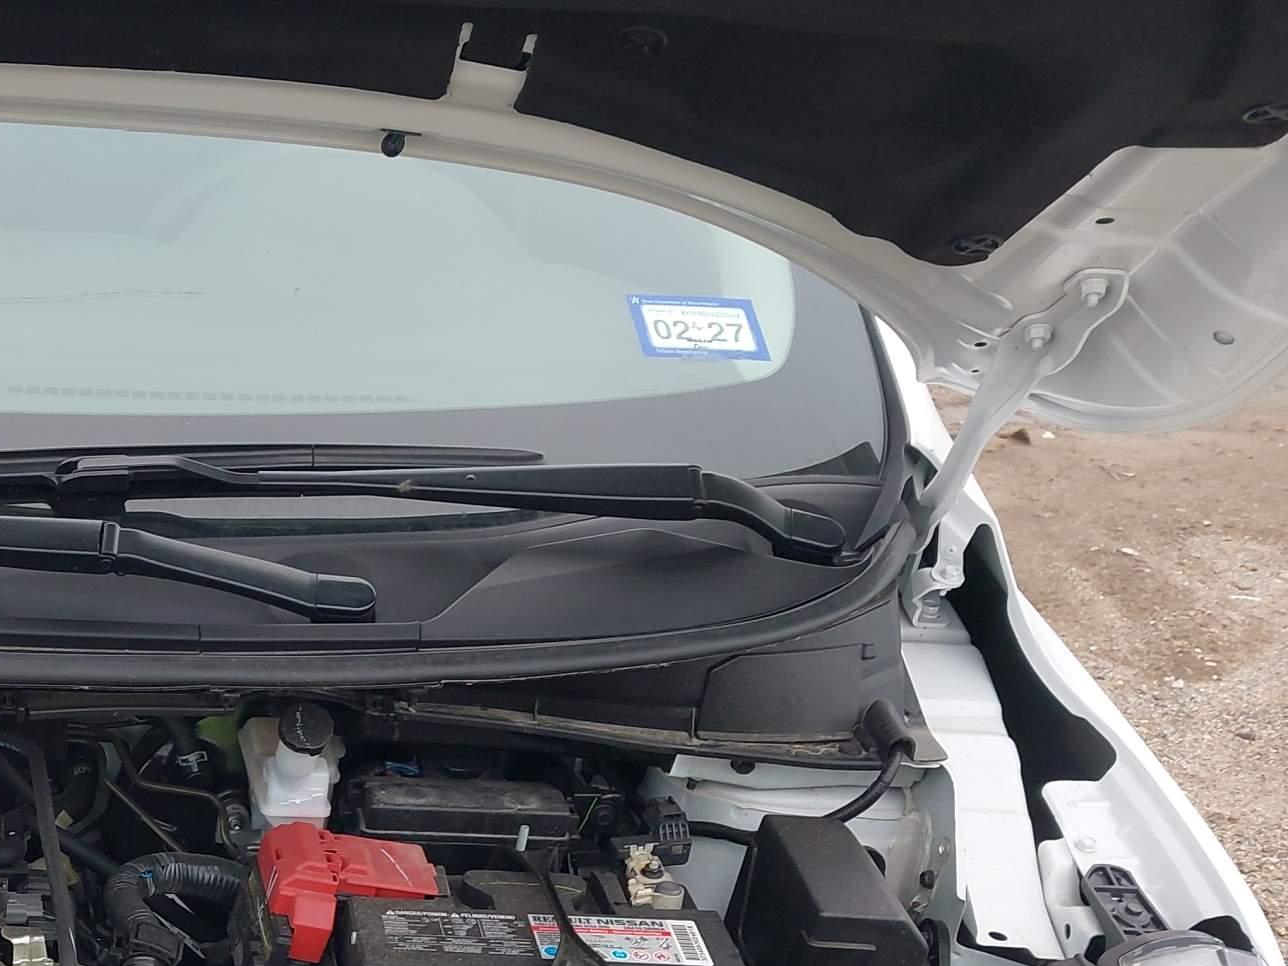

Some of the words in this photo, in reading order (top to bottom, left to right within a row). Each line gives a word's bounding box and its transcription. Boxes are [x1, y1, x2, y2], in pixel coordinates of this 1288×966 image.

[653, 318, 690, 341] 02
[707, 321, 744, 343] 27
[596, 918, 664, 927] NISSAN
